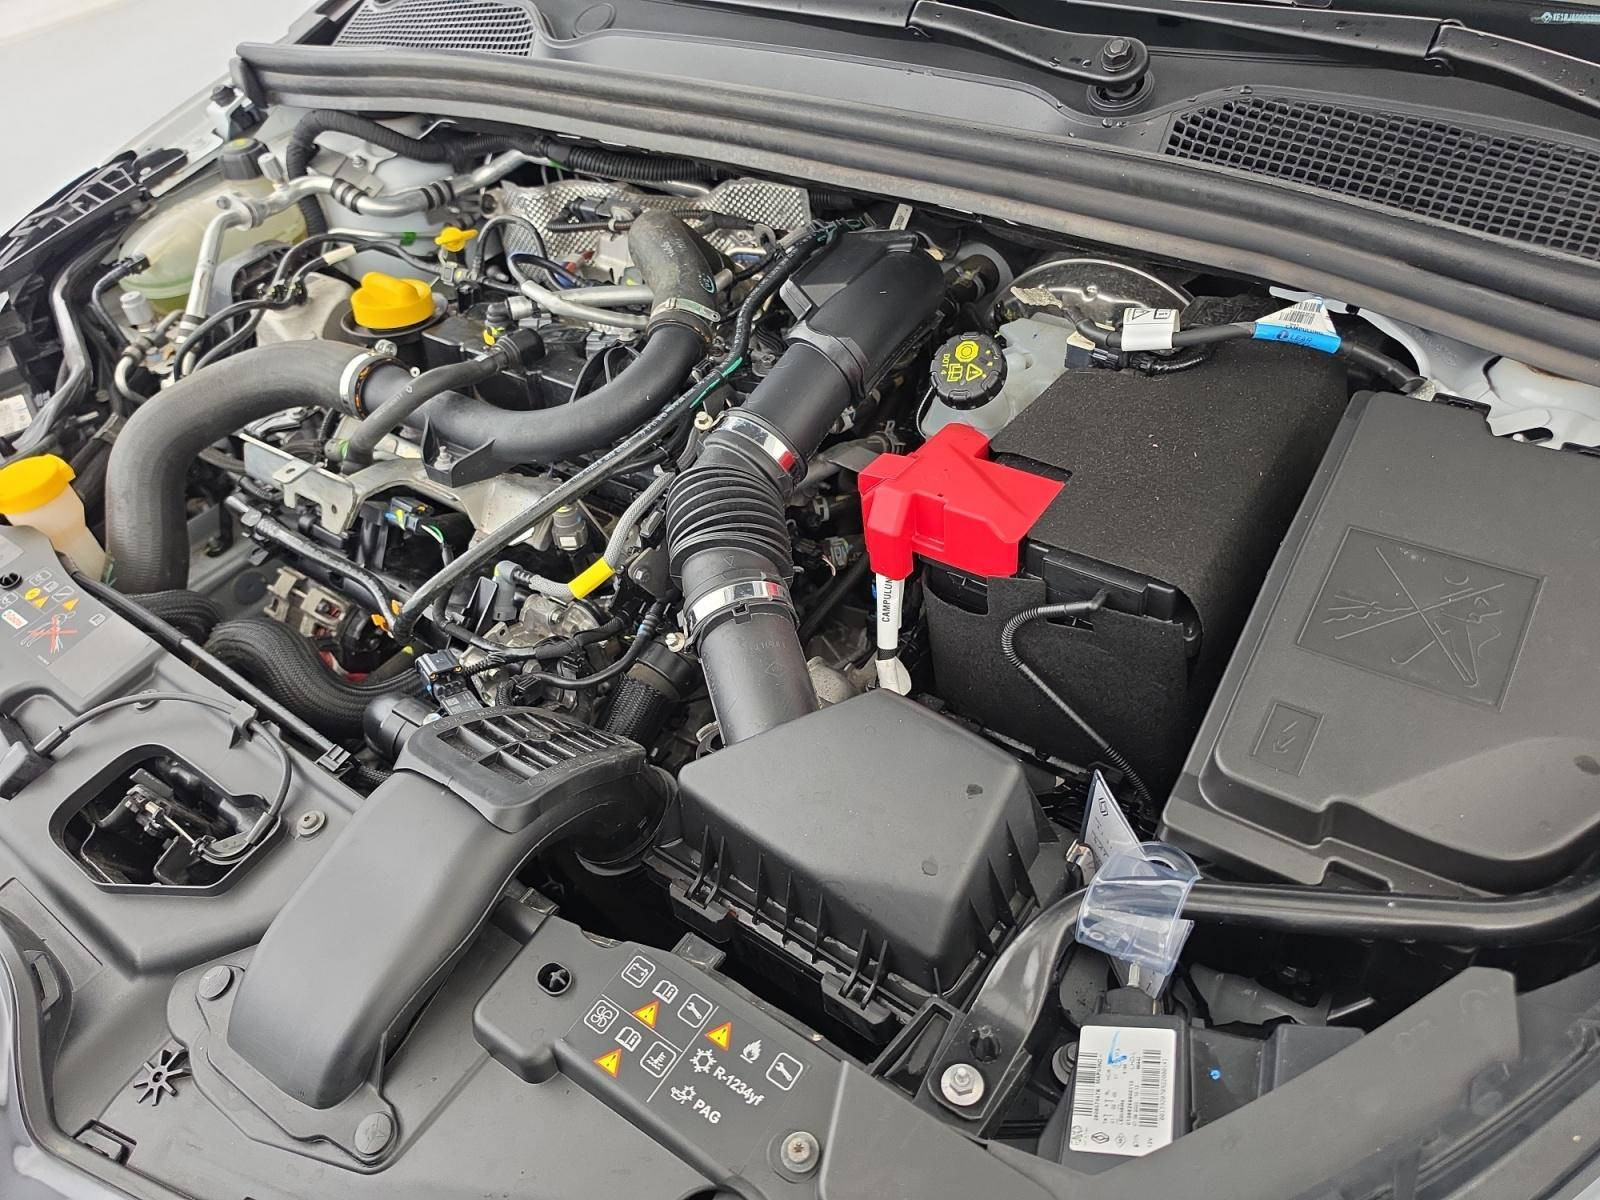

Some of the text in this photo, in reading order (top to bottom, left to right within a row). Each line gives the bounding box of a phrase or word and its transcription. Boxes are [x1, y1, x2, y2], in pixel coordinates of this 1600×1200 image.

[941, 353, 950, 368] DOT
[713, 1066, 765, 1106] R-1234yf
[692, 1099, 721, 1124] PAG
